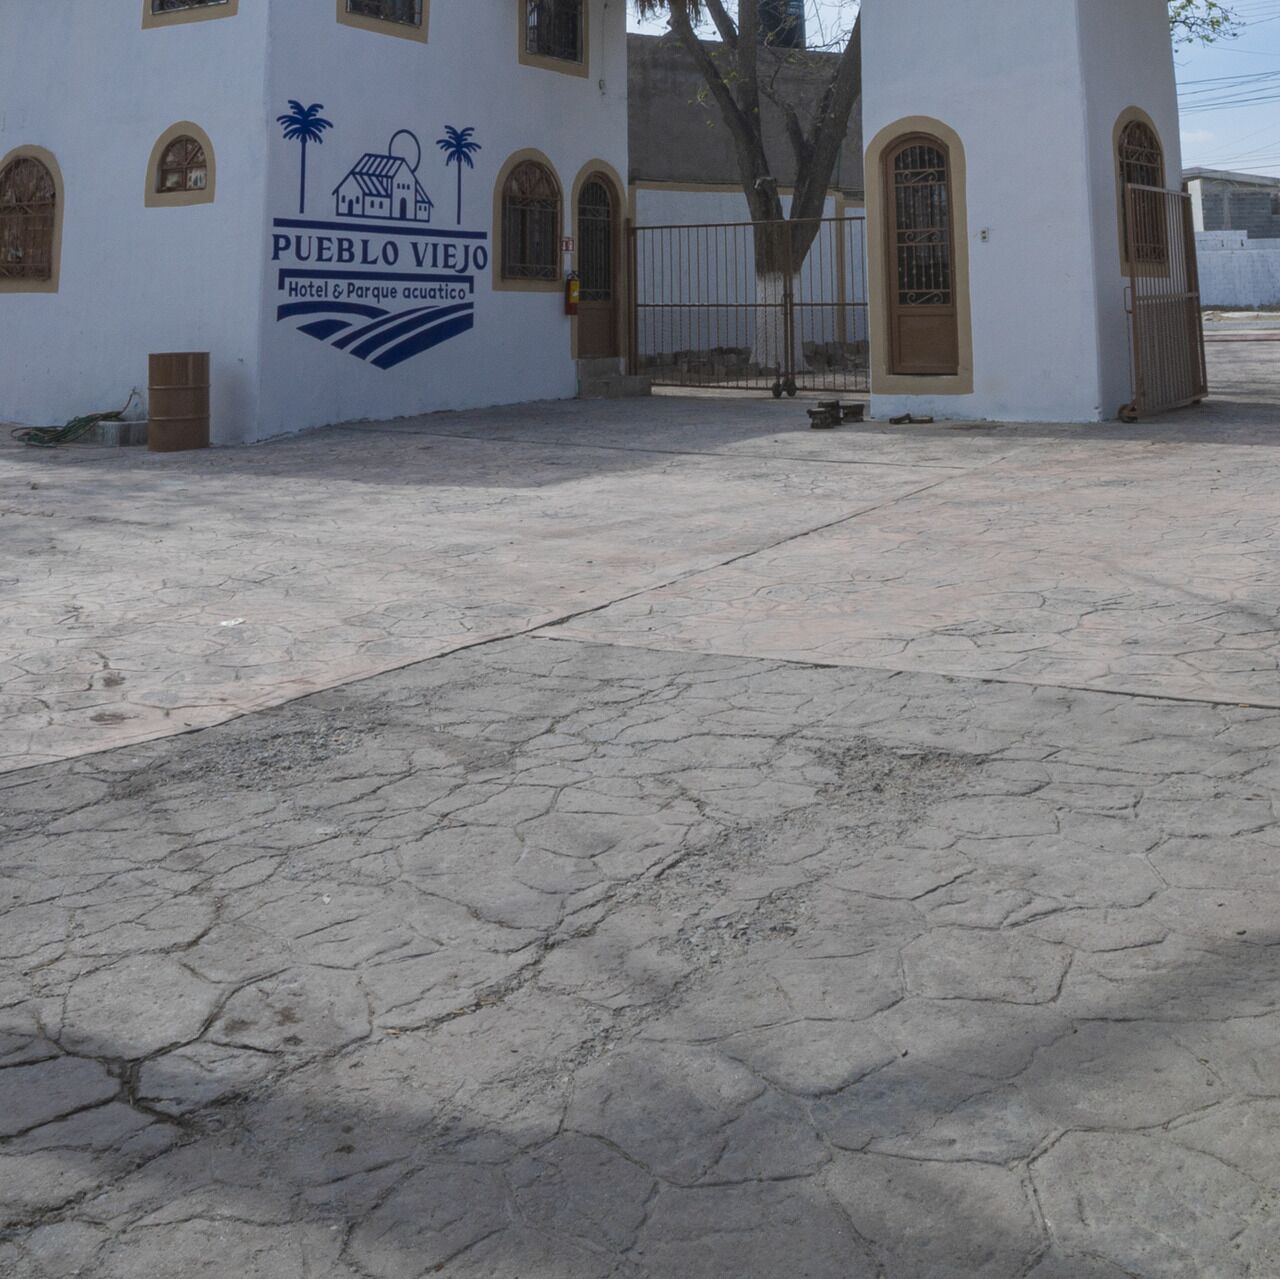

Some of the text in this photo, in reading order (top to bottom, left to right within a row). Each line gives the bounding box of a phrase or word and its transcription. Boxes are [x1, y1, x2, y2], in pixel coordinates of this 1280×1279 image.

[272, 234, 488, 273] PUEBLO VIEJO
[288, 281, 466, 304] Hotel & Parque acuatico
